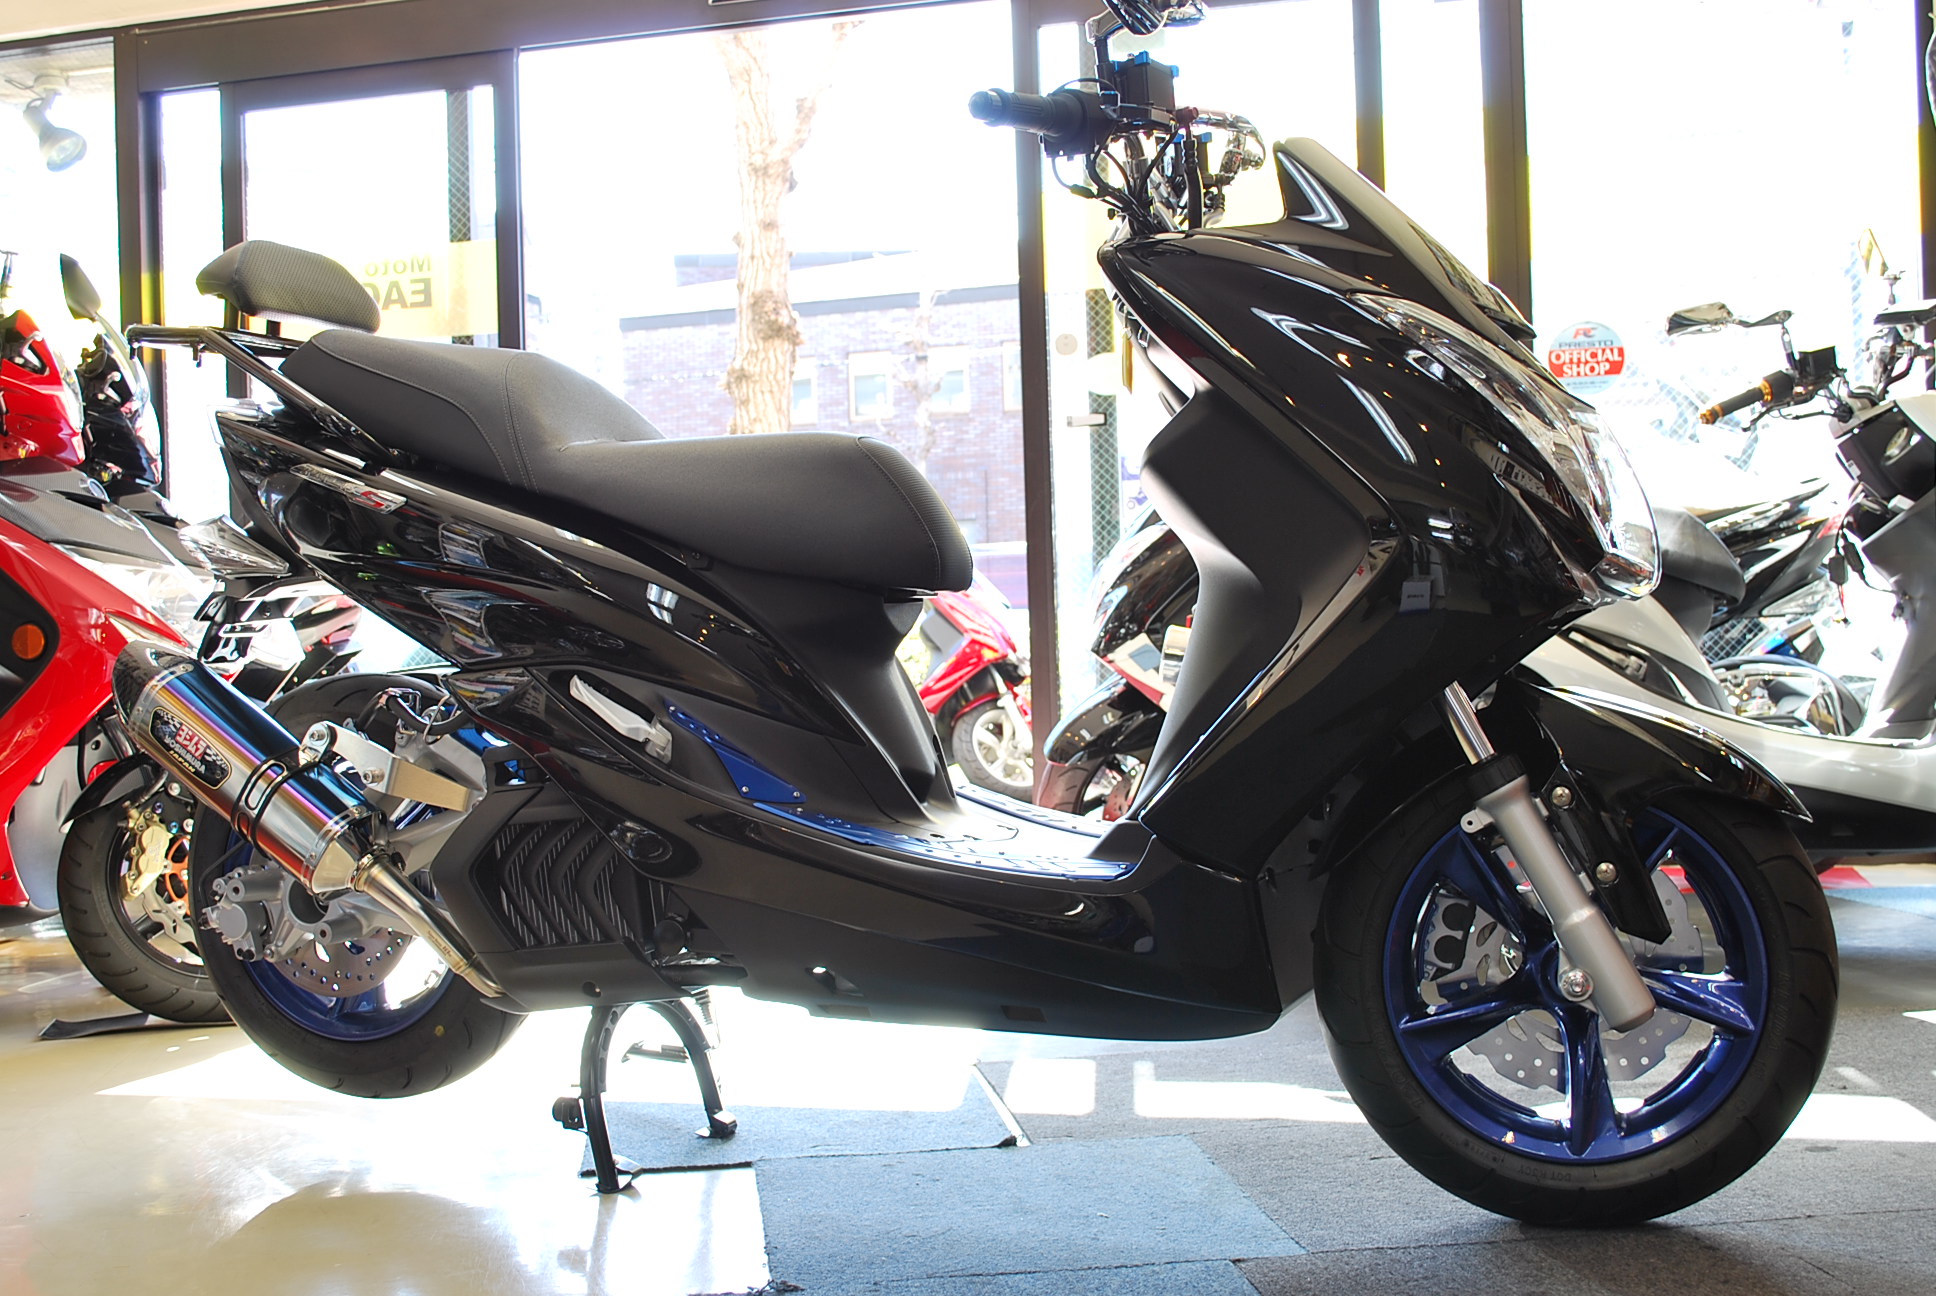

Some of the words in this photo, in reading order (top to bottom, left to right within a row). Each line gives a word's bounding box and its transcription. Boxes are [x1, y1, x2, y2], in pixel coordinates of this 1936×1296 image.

[1558, 339, 1614, 348] PRESTO
[1550, 348, 1623, 365] OFFICIAL
[1562, 361, 1611, 377] SHOP
[164, 734, 206, 774] YOSHIMURA
[169, 750, 196, 773] JAPAN
